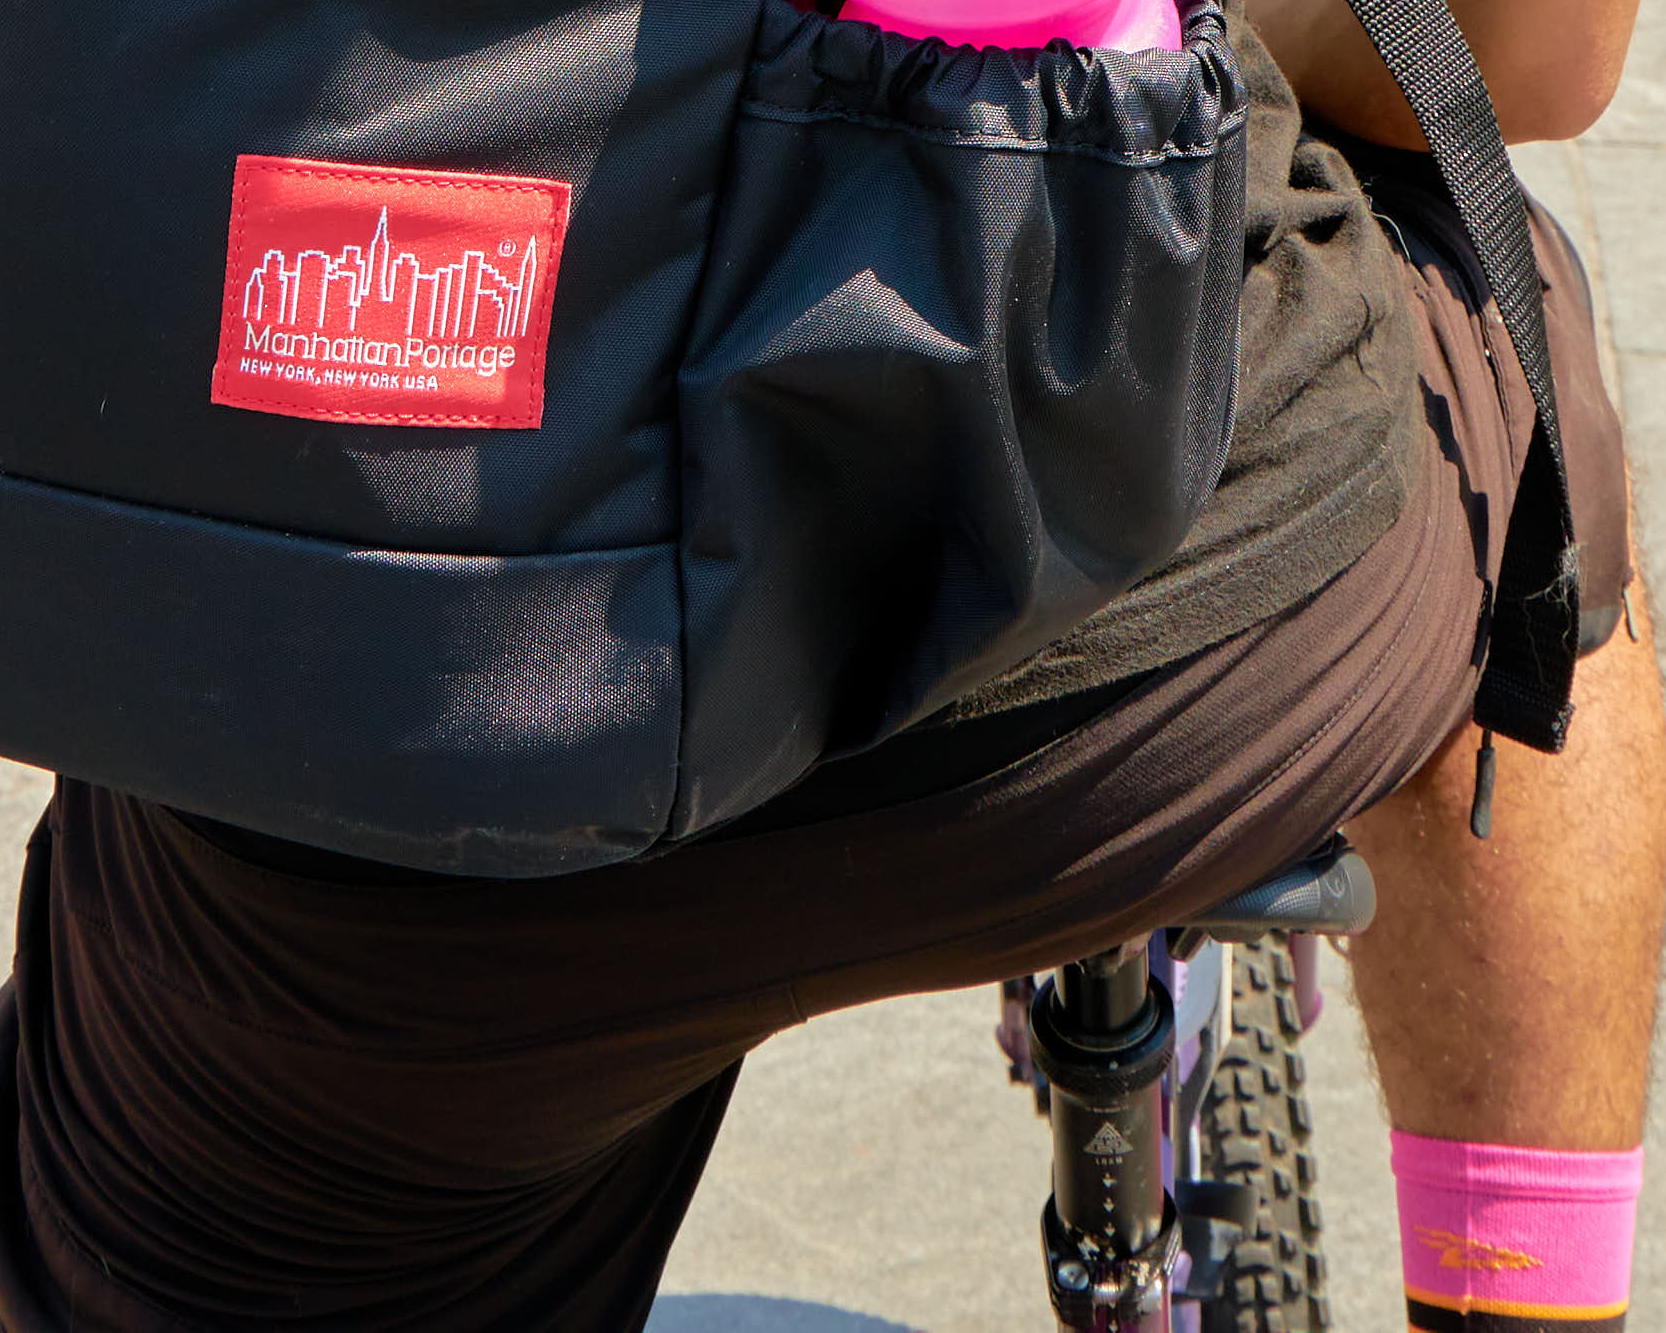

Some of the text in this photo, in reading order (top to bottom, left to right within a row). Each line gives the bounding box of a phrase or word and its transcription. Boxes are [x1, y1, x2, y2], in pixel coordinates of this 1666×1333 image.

[240, 357, 275, 375] NEW
[324, 368, 357, 385] NEW
[359, 371, 400, 389] YORK
[404, 374, 439, 391] USA
